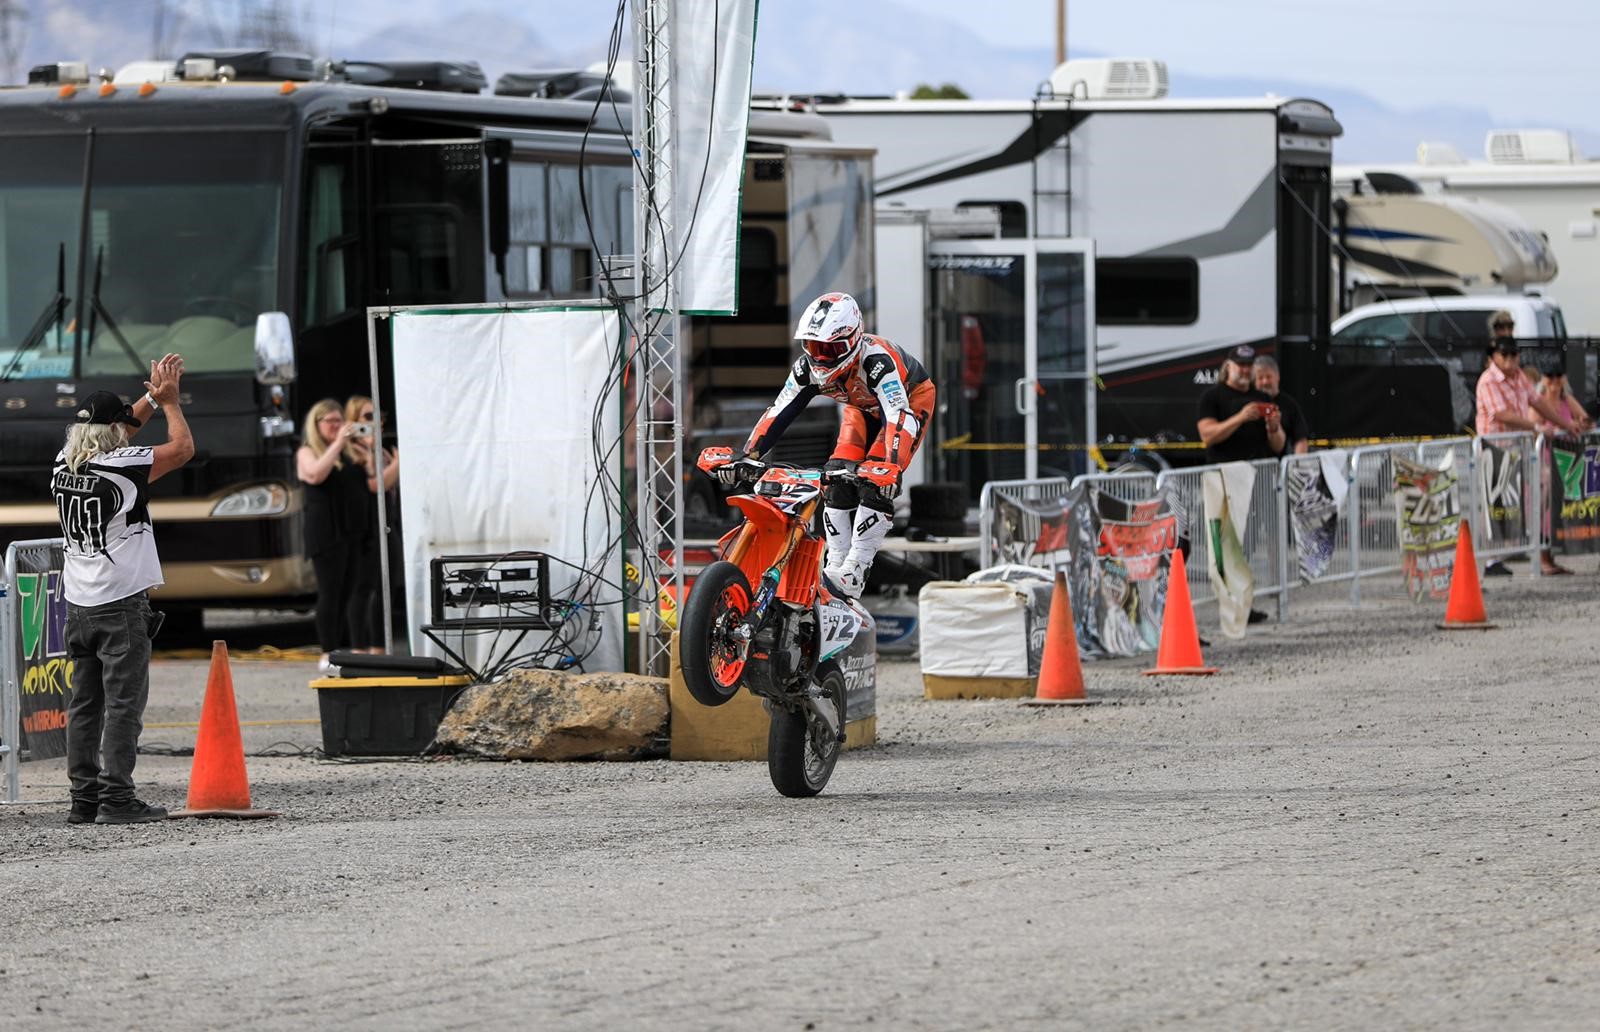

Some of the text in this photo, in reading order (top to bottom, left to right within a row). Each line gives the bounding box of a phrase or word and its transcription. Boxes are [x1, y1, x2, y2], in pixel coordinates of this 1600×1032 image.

[57, 472, 99, 493] HART
[56, 493, 105, 556] 141
[825, 614, 855, 642] 72
